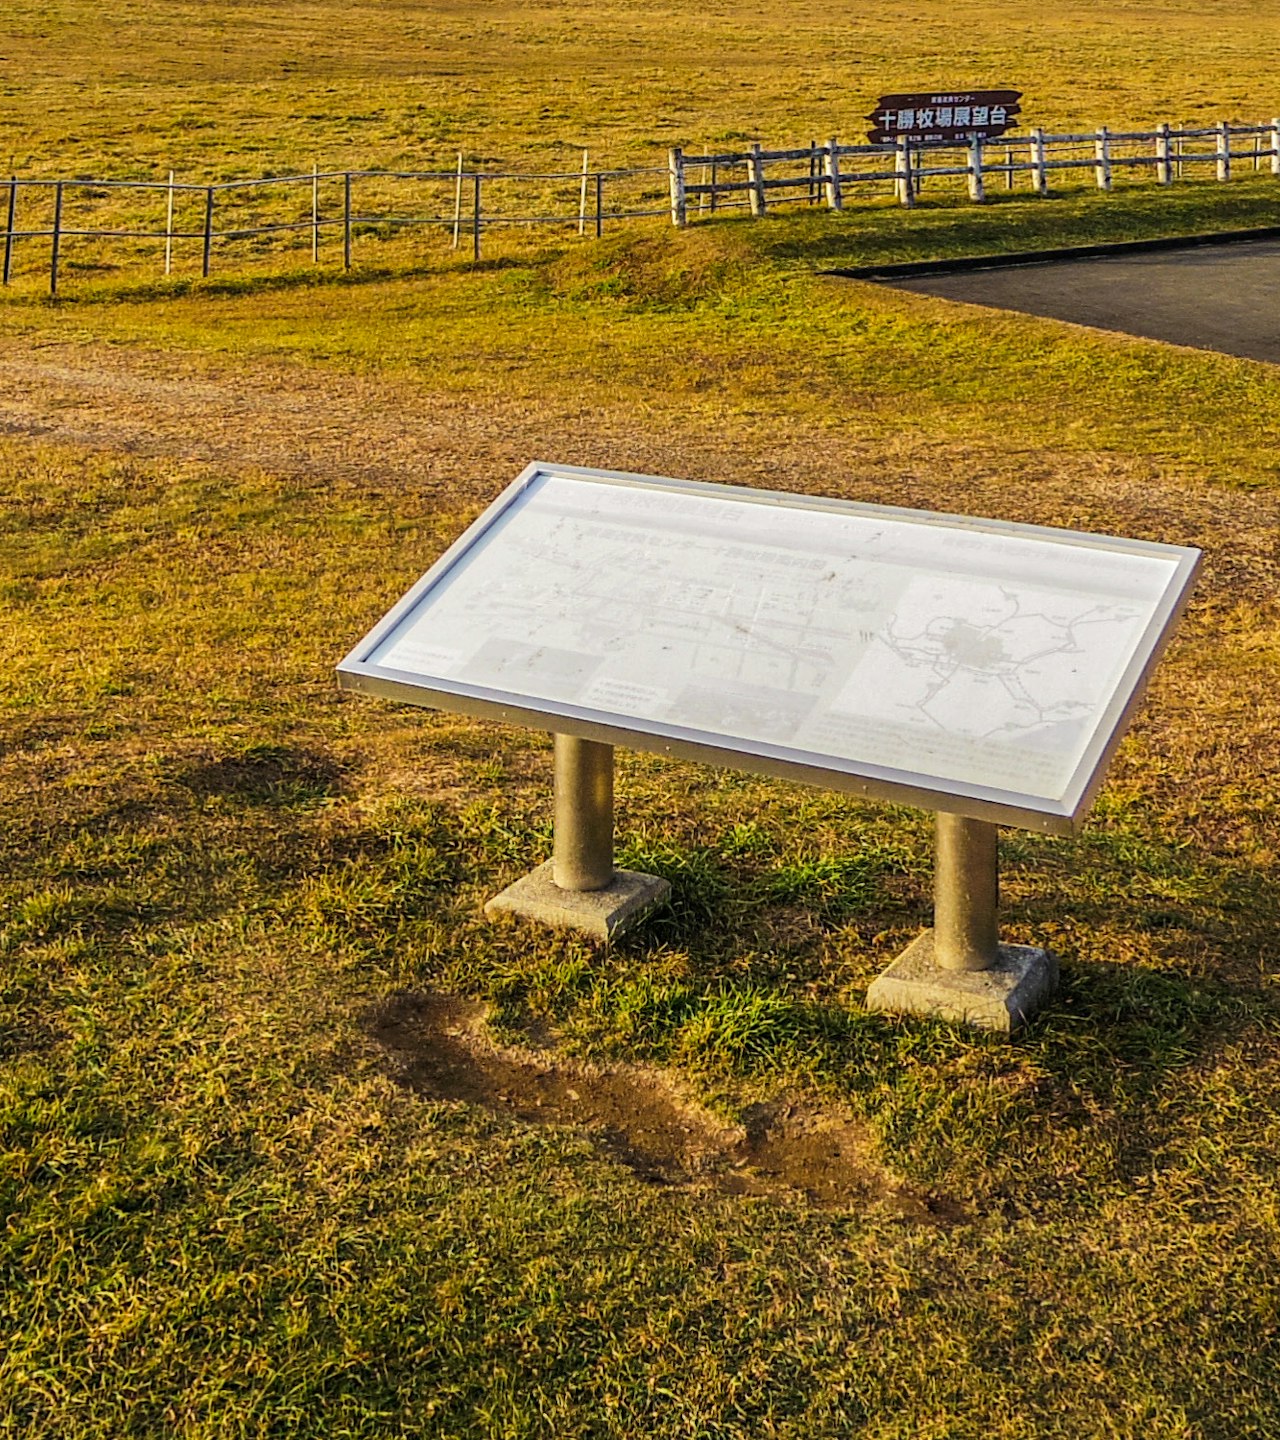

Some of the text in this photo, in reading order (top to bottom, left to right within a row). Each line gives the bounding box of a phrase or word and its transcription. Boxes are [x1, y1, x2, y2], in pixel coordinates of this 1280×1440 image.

[878, 104, 1007, 131] 十勝牧場展望台
